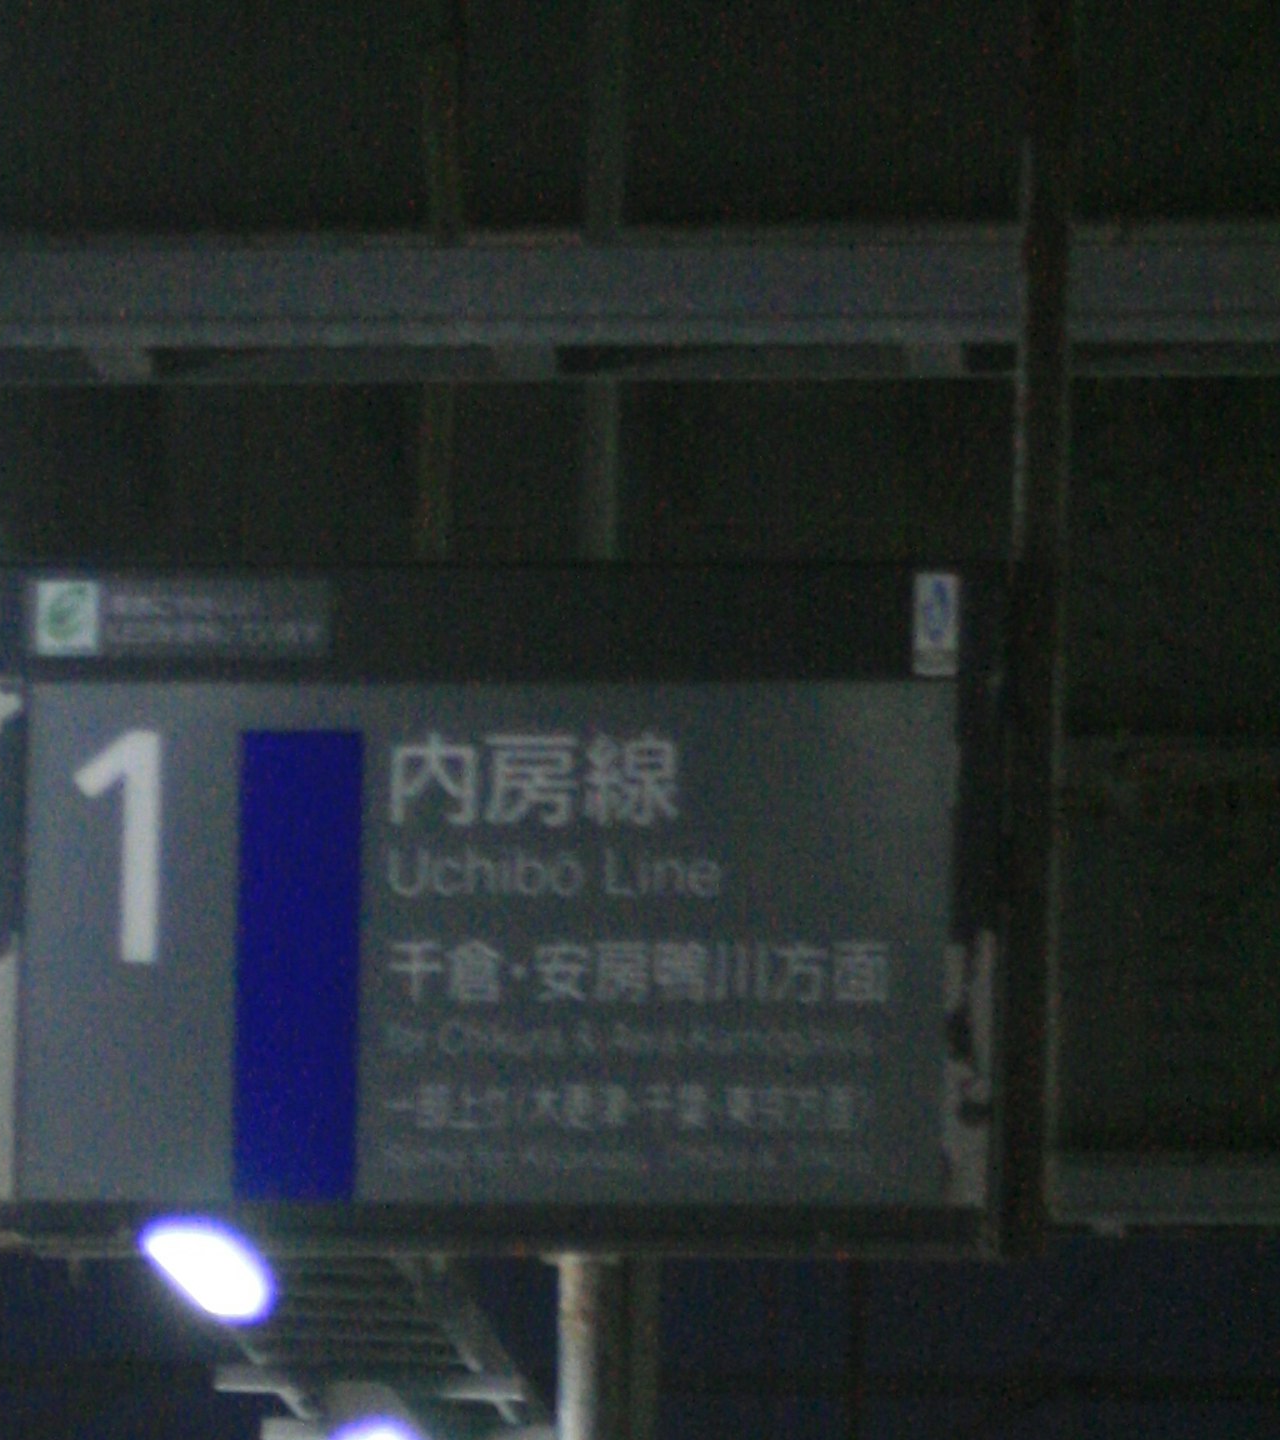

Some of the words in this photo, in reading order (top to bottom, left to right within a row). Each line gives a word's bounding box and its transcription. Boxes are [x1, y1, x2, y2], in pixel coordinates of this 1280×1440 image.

[387, 733, 680, 827] 内房線
[74, 728, 163, 965] 1
[603, 847, 725, 898] Line
